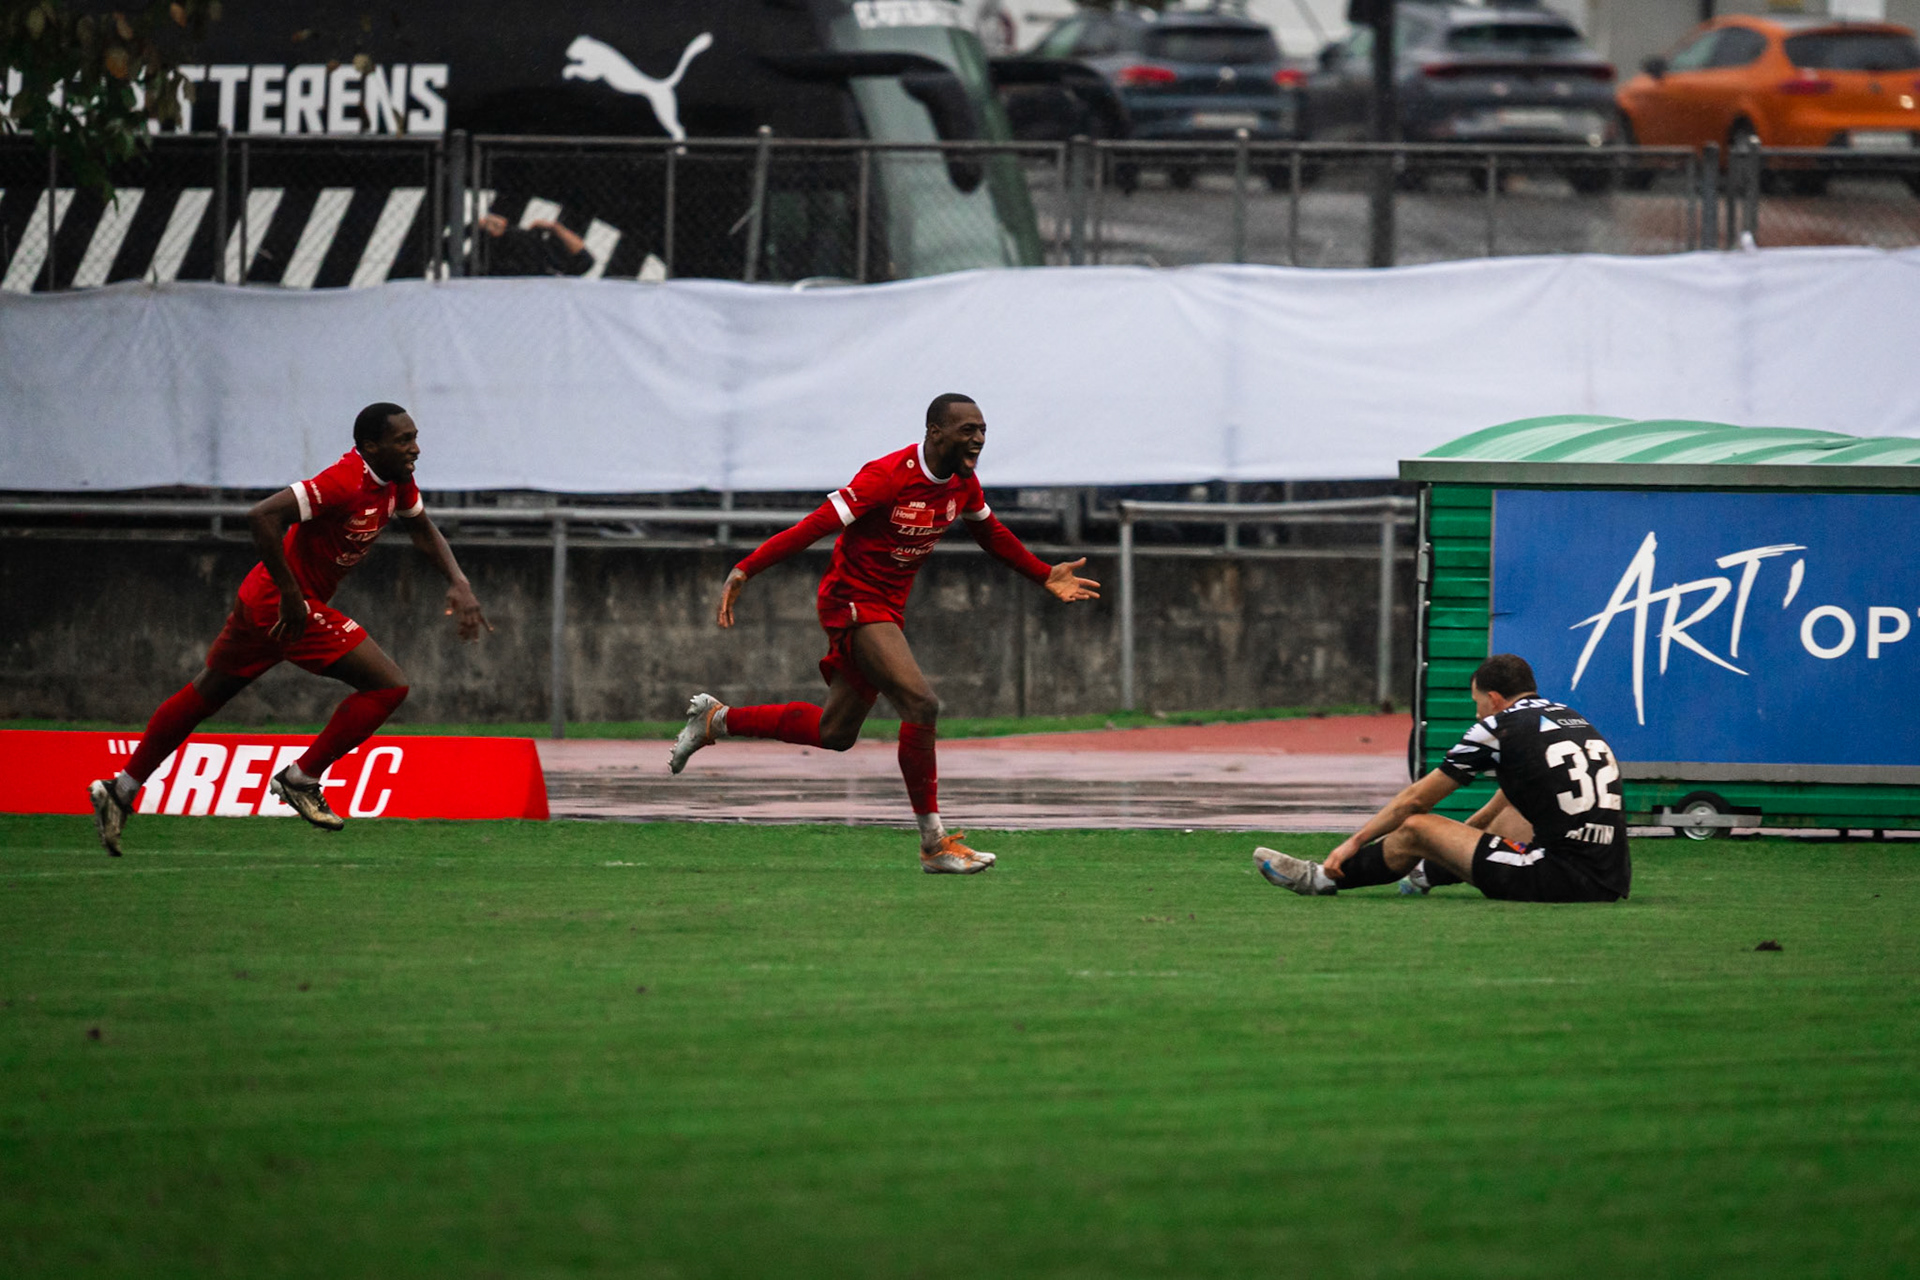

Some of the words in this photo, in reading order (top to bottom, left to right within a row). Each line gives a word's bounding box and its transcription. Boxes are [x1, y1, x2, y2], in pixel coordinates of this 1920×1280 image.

[130, 64, 448, 134] TTERENS
[1800, 605, 1920, 659] OP
[1545, 739, 1622, 816] 32
